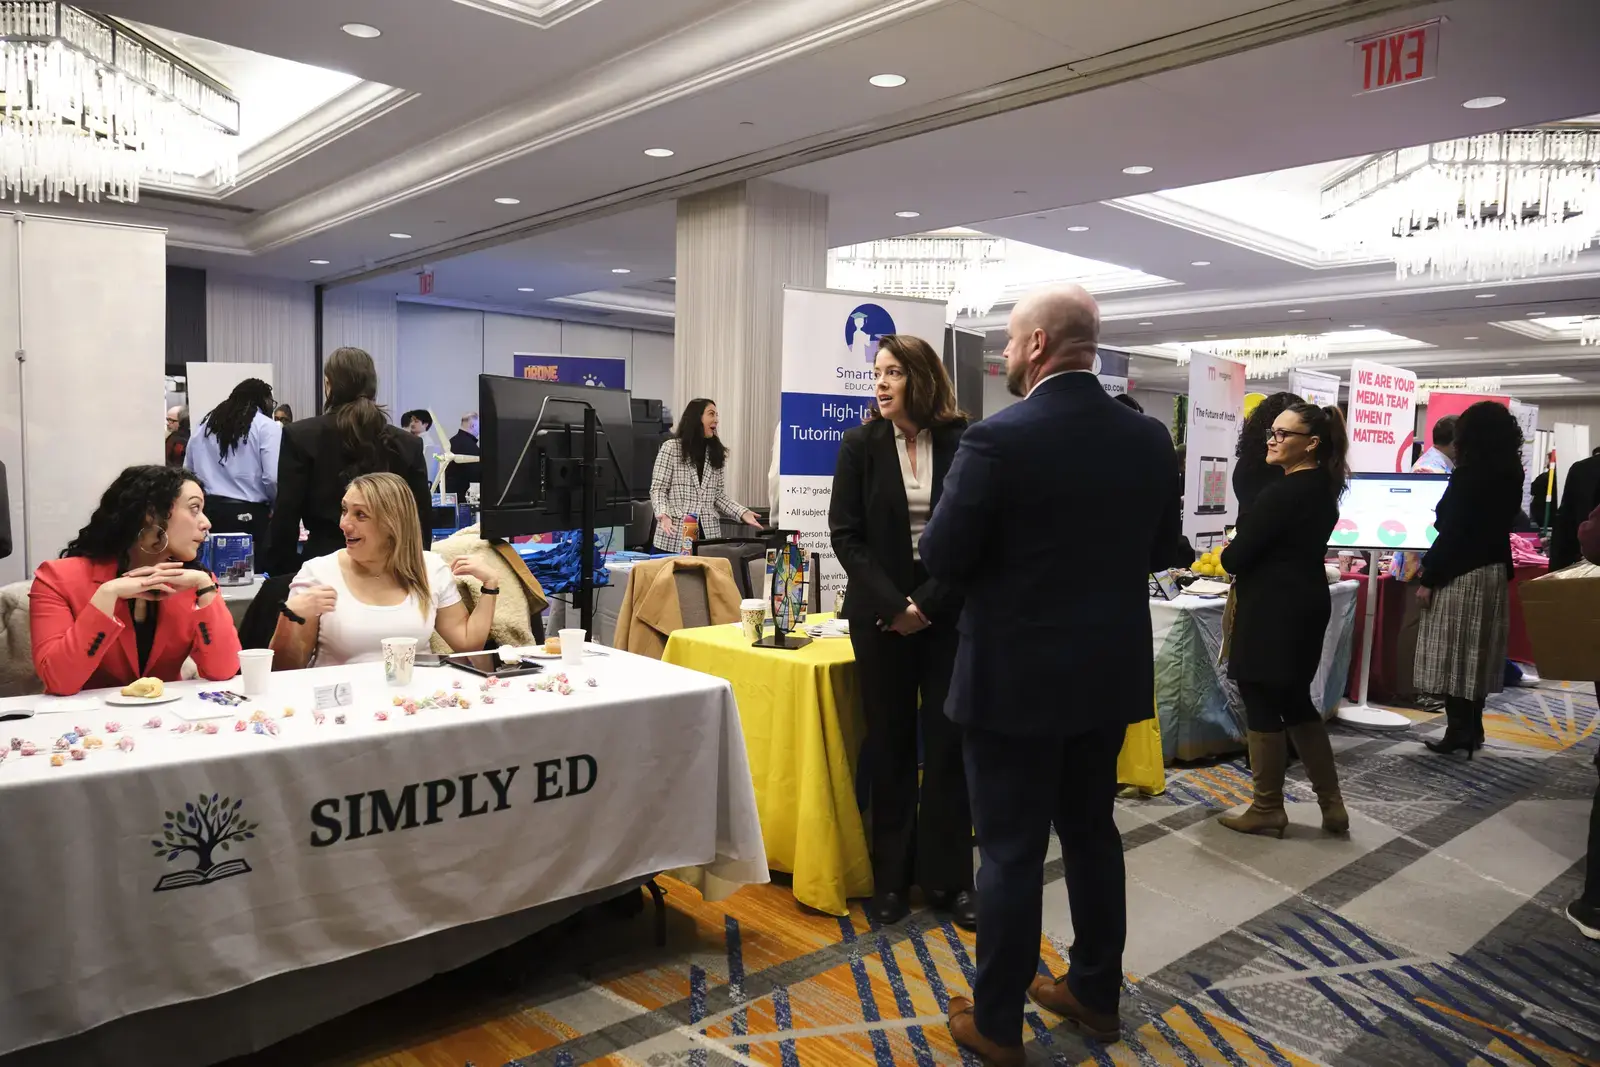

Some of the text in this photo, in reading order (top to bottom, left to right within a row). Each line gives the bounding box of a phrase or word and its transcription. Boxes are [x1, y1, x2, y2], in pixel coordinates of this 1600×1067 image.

[844, 382, 876, 391] EDUCA
[1358, 370, 1415, 393] WE ARE YOUR
[1356, 389, 1409, 410] MEDIA TEAM
[1355, 408, 1392, 426] WHEN IT
[1352, 428, 1396, 445] MATTERS.
[791, 508, 801, 516] All
[802, 509, 826, 518] subject
[310, 754, 598, 847] SIMPLY ED
